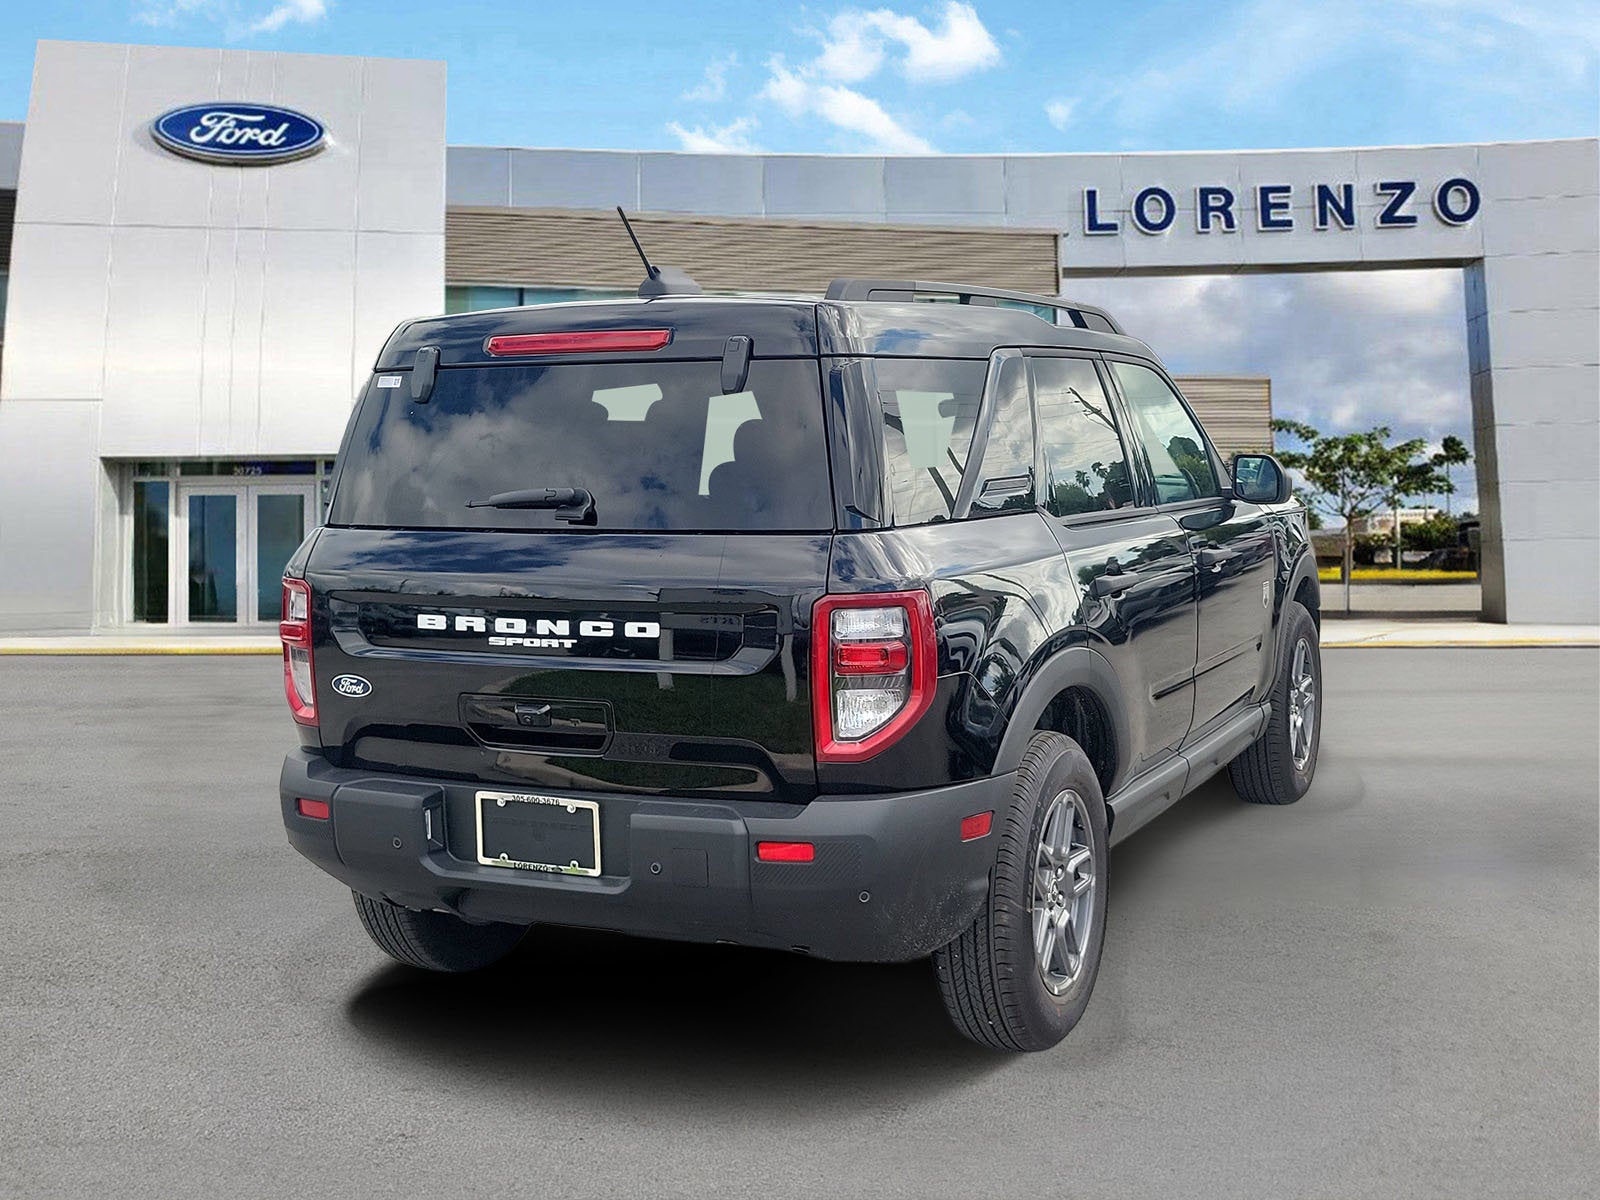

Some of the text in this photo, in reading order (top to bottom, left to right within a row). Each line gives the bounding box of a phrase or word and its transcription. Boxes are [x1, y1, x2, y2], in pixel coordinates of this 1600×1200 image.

[189, 111, 291, 147] Ford
[1083, 177, 1482, 235] LORENZO
[416, 613, 661, 638] BRONCO
[488, 636, 578, 649] SPORT
[339, 677, 364, 694] Ford
